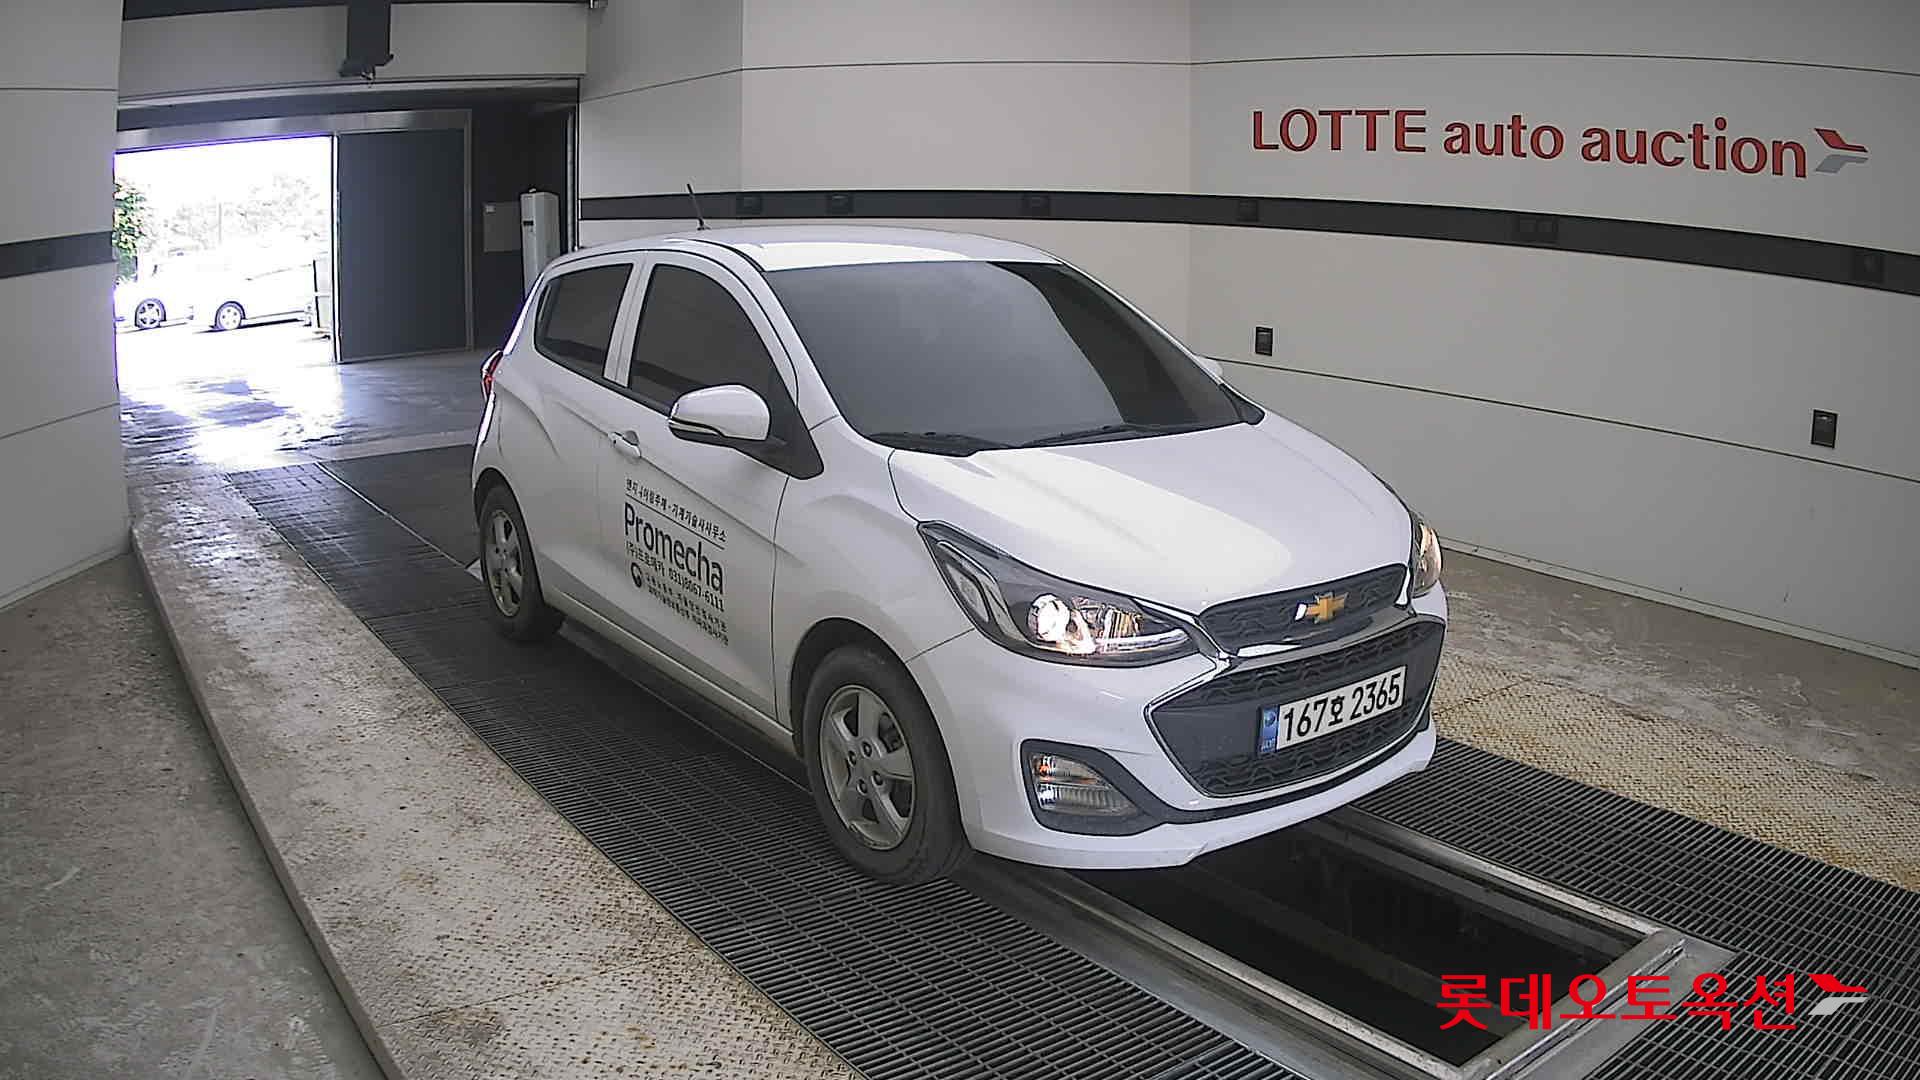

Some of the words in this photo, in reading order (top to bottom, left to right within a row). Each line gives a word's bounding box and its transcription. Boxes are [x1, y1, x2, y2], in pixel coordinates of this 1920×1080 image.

[1252, 109, 1427, 153] LOTTE
[1442, 113, 1565, 160] auto
[1581, 116, 1807, 179] auction
[624, 501, 724, 595] Promecha
[1284, 695, 1345, 741] 167호
[1350, 671, 1402, 721] 2365
